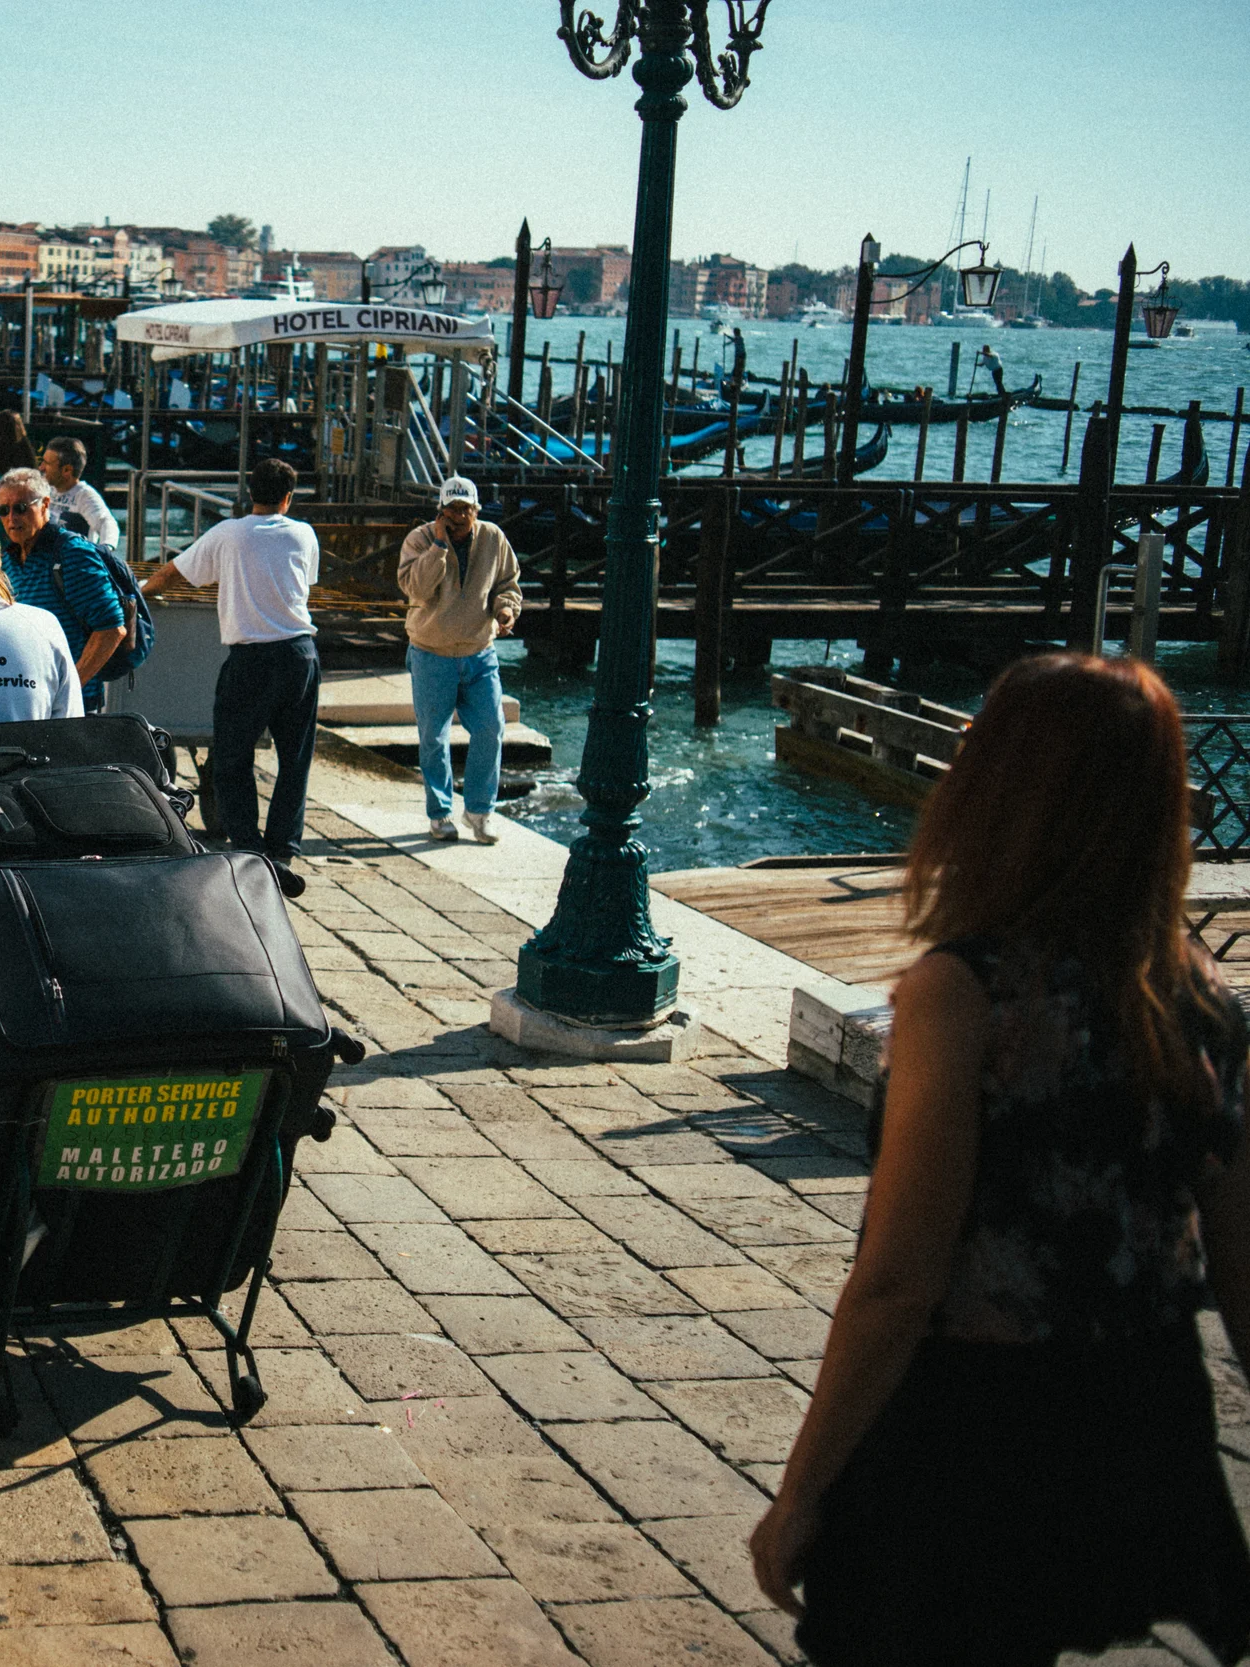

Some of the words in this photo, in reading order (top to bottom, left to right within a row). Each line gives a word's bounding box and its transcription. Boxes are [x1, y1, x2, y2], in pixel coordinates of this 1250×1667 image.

[273, 310, 350, 334] HOTEL
[357, 309, 458, 335] CIPRIANI
[71, 1086, 151, 1106] PORTER
[157, 1081, 243, 1103] SERVICE
[67, 1101, 238, 1126] AUTHORIZED
[60, 1139, 228, 1164] MALETERO
[56, 1156, 222, 1182] AUTORIZADO
